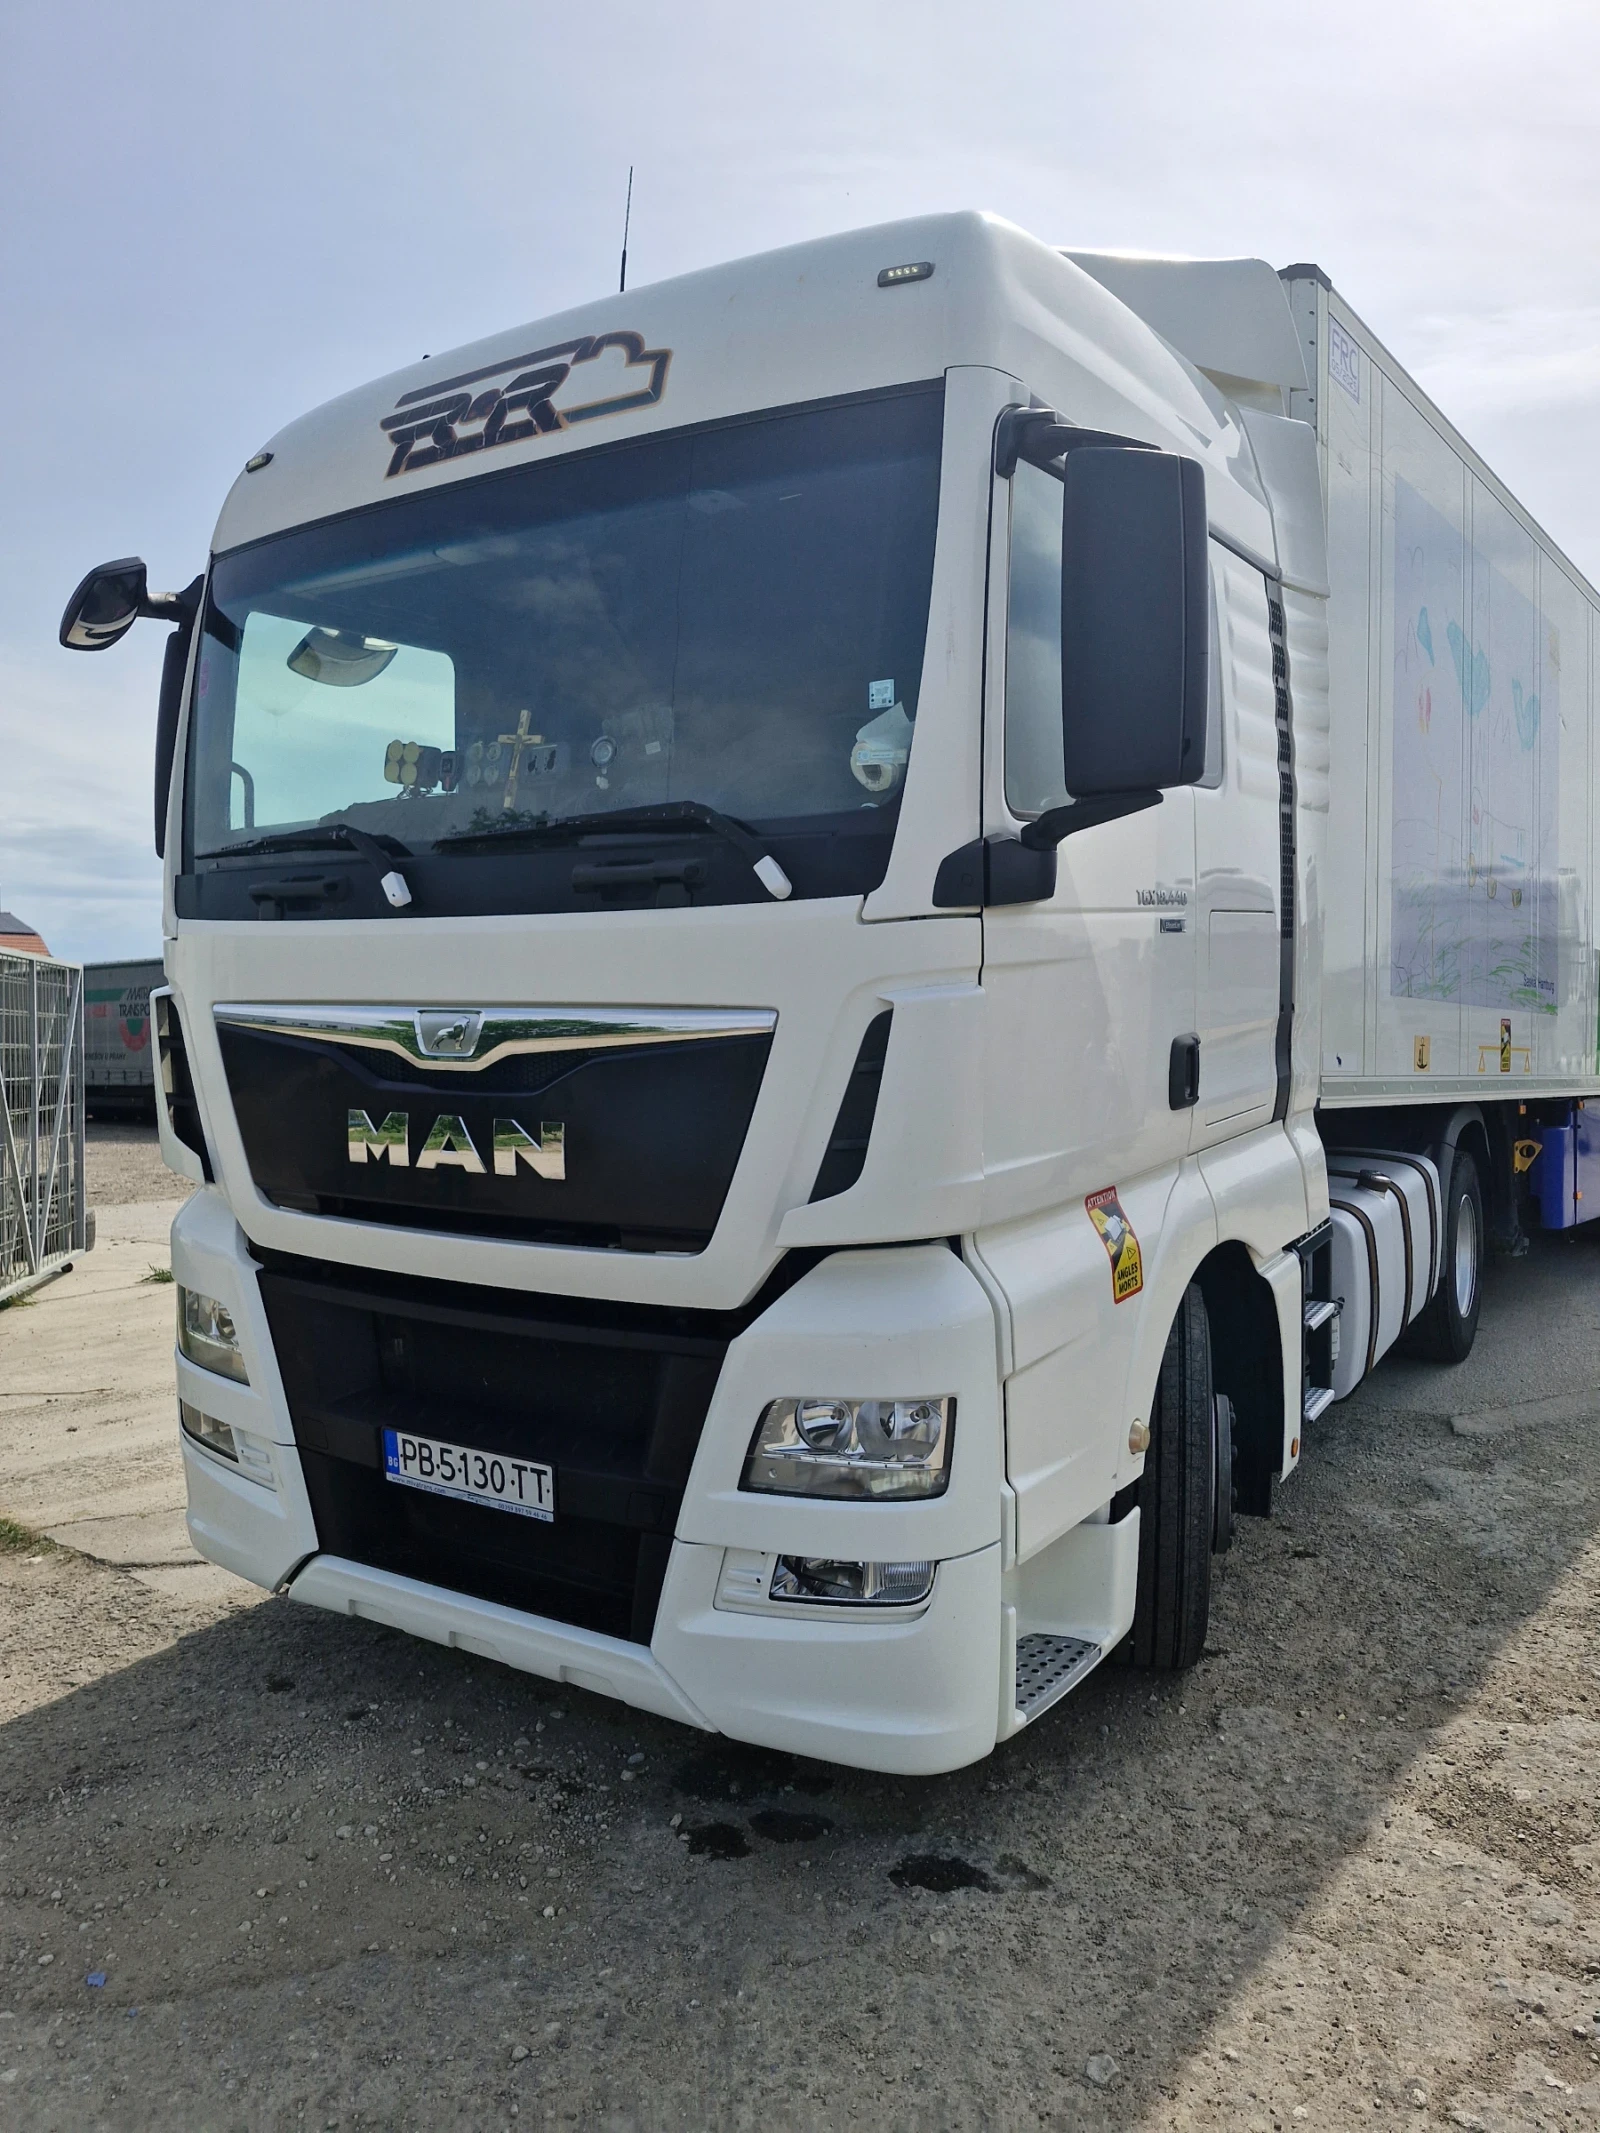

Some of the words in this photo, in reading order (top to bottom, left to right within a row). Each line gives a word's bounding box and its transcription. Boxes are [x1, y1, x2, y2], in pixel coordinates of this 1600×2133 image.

[1332, 328, 1357, 379] FRC
[1136, 889, 1155, 905] TGX
[1156, 890, 1188, 906] 18.440
[119, 1003, 150, 1017] TRANSPO
[348, 1108, 566, 1181] MAN
[1087, 1190, 1116, 1208] ATTENTION
[1117, 1263, 1138, 1282] ANGLES
[1118, 1276, 1138, 1294] MORTS
[387, 1456, 399, 1469] BG
